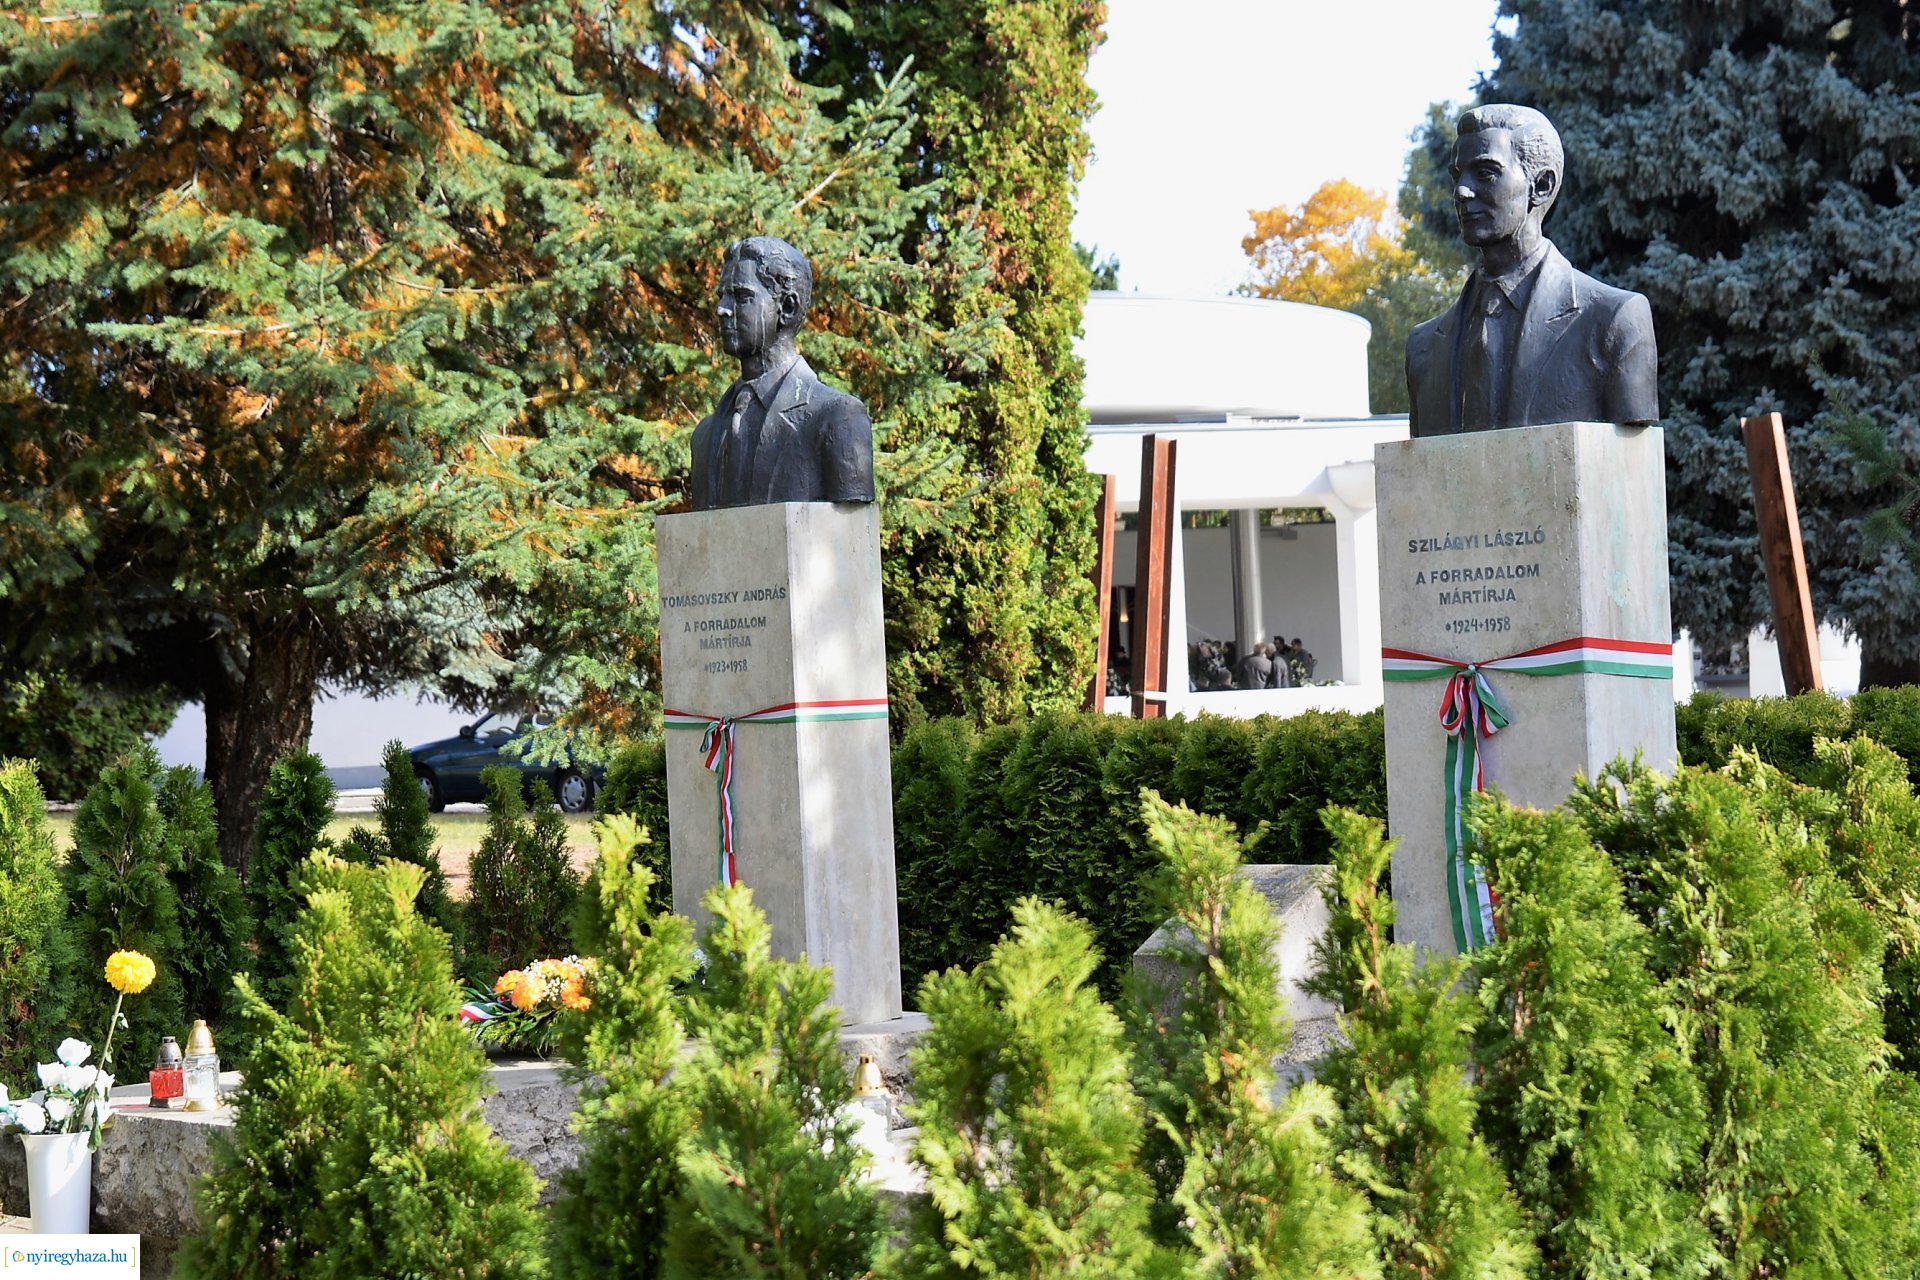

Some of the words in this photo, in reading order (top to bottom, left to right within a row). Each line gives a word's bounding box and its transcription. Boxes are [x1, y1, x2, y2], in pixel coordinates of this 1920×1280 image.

[1408, 532, 1479, 554] SZILÁGYI
[1484, 525, 1546, 548] LÁSZLÓ
[1416, 571, 1426, 585] A
[1430, 563, 1540, 584] FORRADALOM
[662, 592, 738, 608] TOMASOVSZKY
[743, 584, 786, 602] ANDRÁS
[1439, 585, 1516, 605] MÁRTÍRJA
[684, 622, 691, 633] A
[695, 617, 766, 631] FORRADALOM
[700, 634, 752, 650] MÁRTÍRJA
